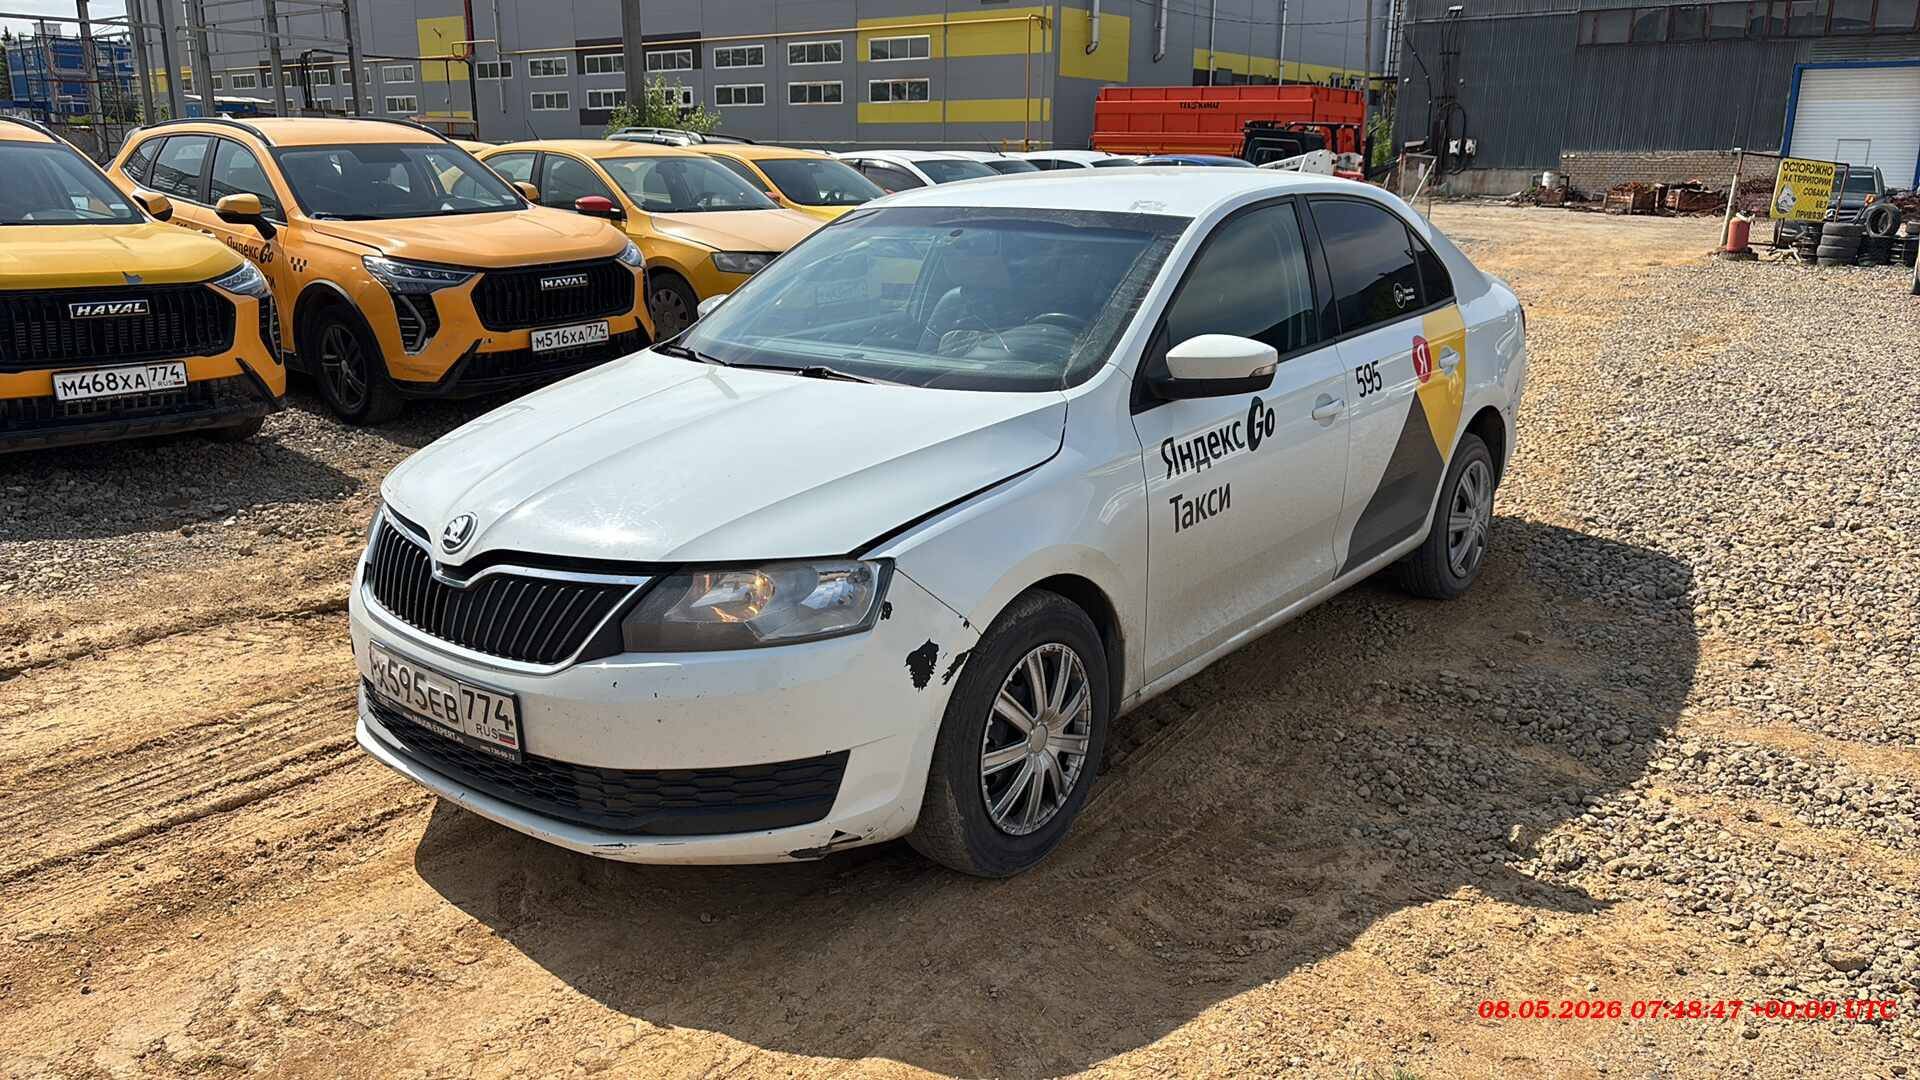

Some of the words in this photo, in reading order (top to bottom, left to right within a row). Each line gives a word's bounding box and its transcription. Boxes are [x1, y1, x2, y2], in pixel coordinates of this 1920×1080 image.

[1783, 161, 1833, 176] ОСТОРОЖНО
[1803, 187, 1829, 197] СОБАКА
[260, 243, 274, 264] Go
[544, 276, 588, 289] HAVAL
[76, 302, 146, 316] HAVAL
[535, 330, 586, 349] М516ХА
[586, 324, 606, 337] 774
[1417, 343, 1429, 375] Я
[62, 372, 146, 397] М468ХА
[148, 365, 181, 382] 774
[1355, 360, 1382, 397] 595
[1161, 421, 1246, 480] Яндекс
[1247, 396, 1275, 451] Go
[1169, 483, 1231, 533] Такси
[377, 658, 459, 724] Х595ЕВ
[462, 689, 510, 731] 774
[475, 723, 499, 740] RUS
